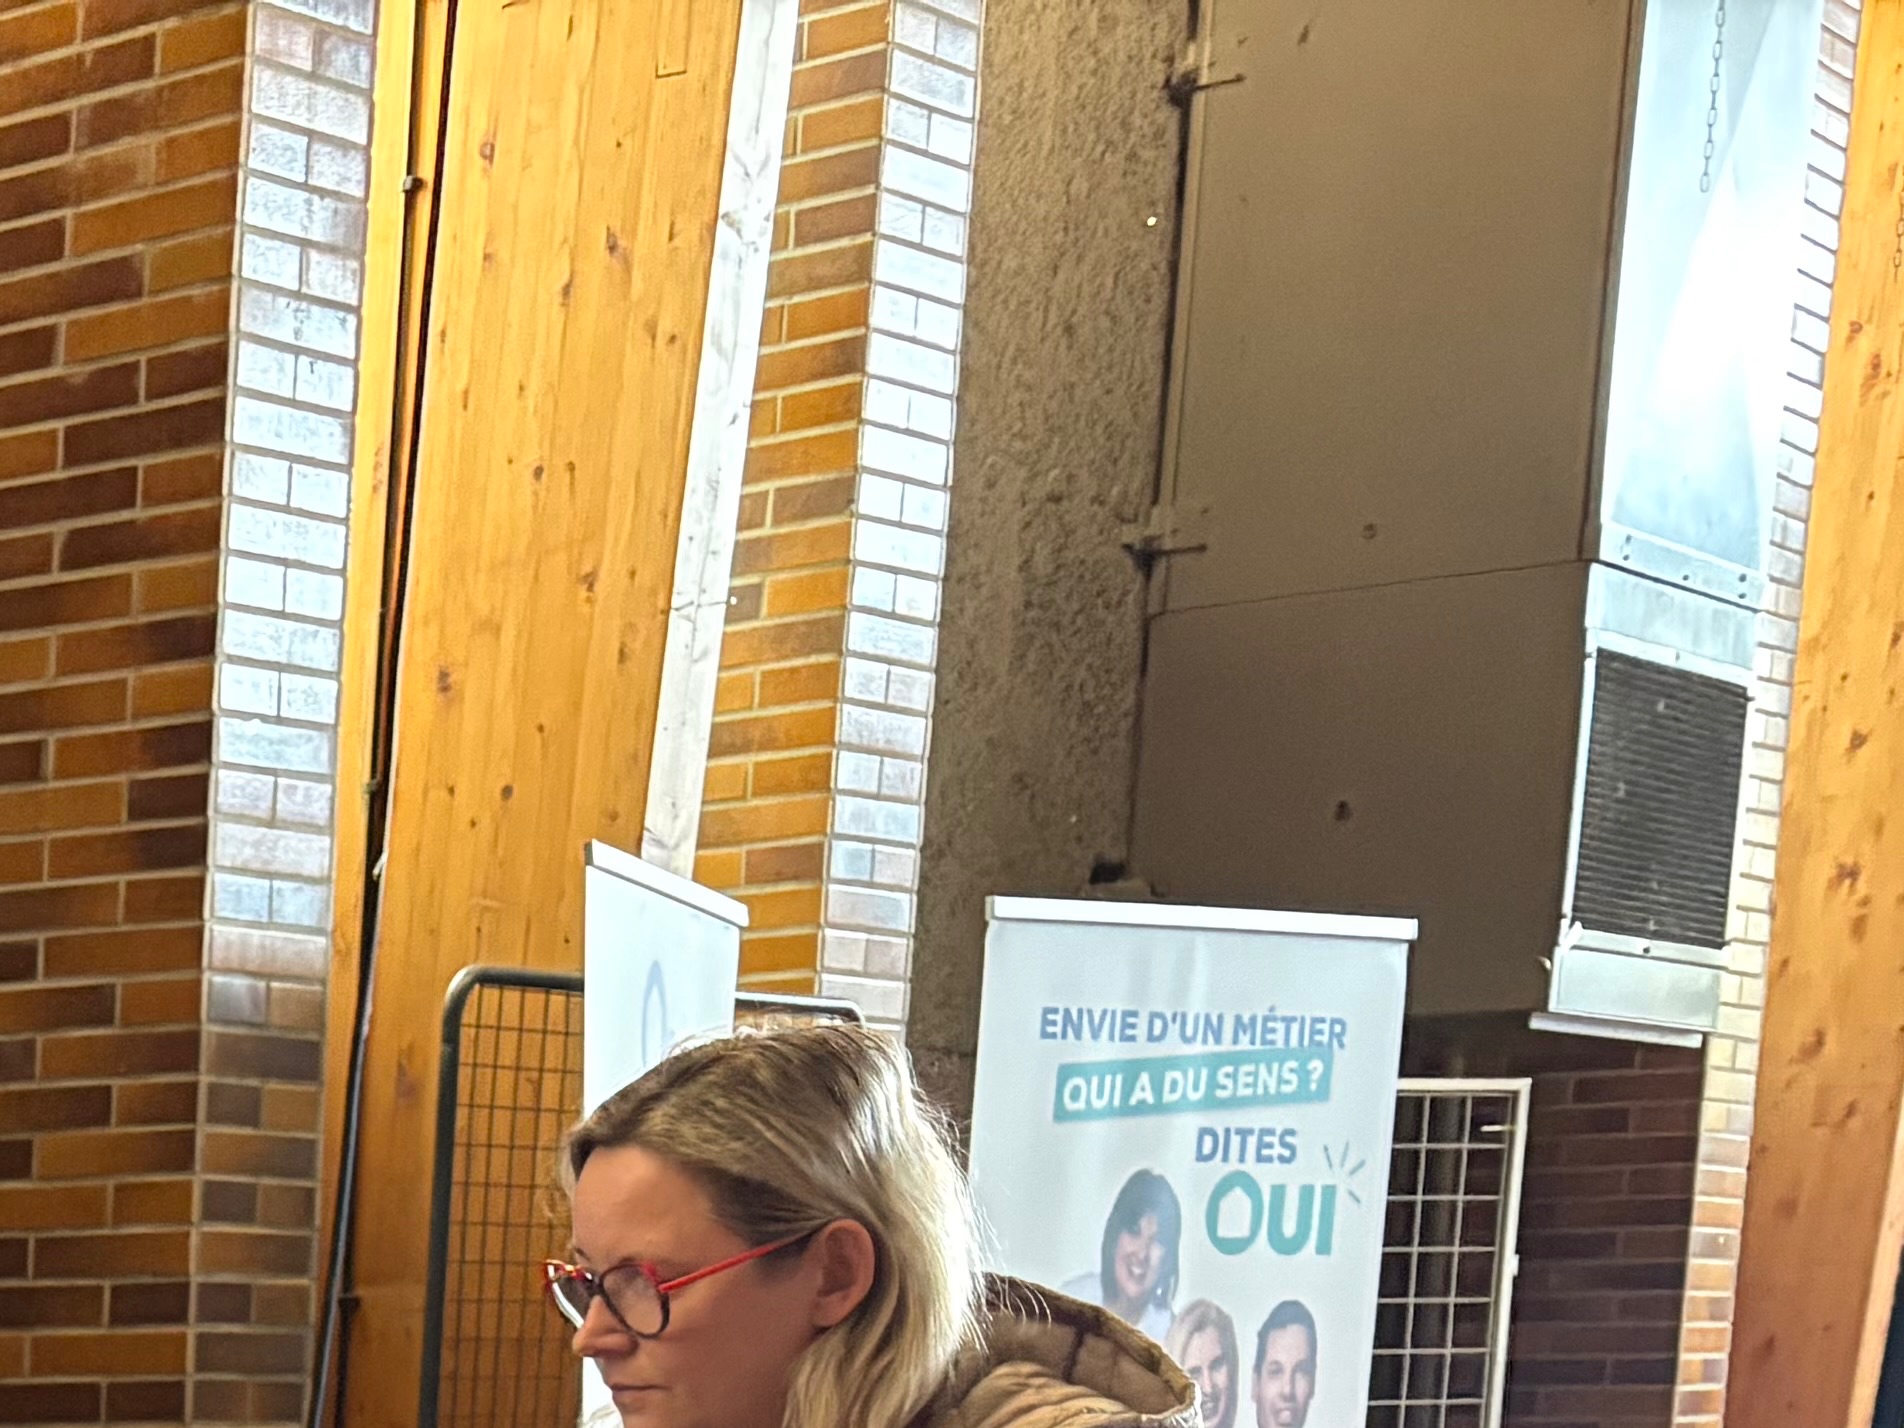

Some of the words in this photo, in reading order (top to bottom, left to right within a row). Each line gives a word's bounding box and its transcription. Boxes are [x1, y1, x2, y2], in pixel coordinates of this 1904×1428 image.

[1039, 1006, 1139, 1042] ENVIE
[1146, 1010, 1224, 1045] D'UN
[1232, 1004, 1347, 1050] MÉTIER
[1063, 1072, 1123, 1111] QUI
[1129, 1072, 1155, 1106] A
[1162, 1070, 1207, 1104] DU
[1214, 1060, 1299, 1098] SENS
[1307, 1058, 1324, 1092] ?
[1195, 1126, 1299, 1164] DITES
[1205, 1169, 1338, 1256] OUI
